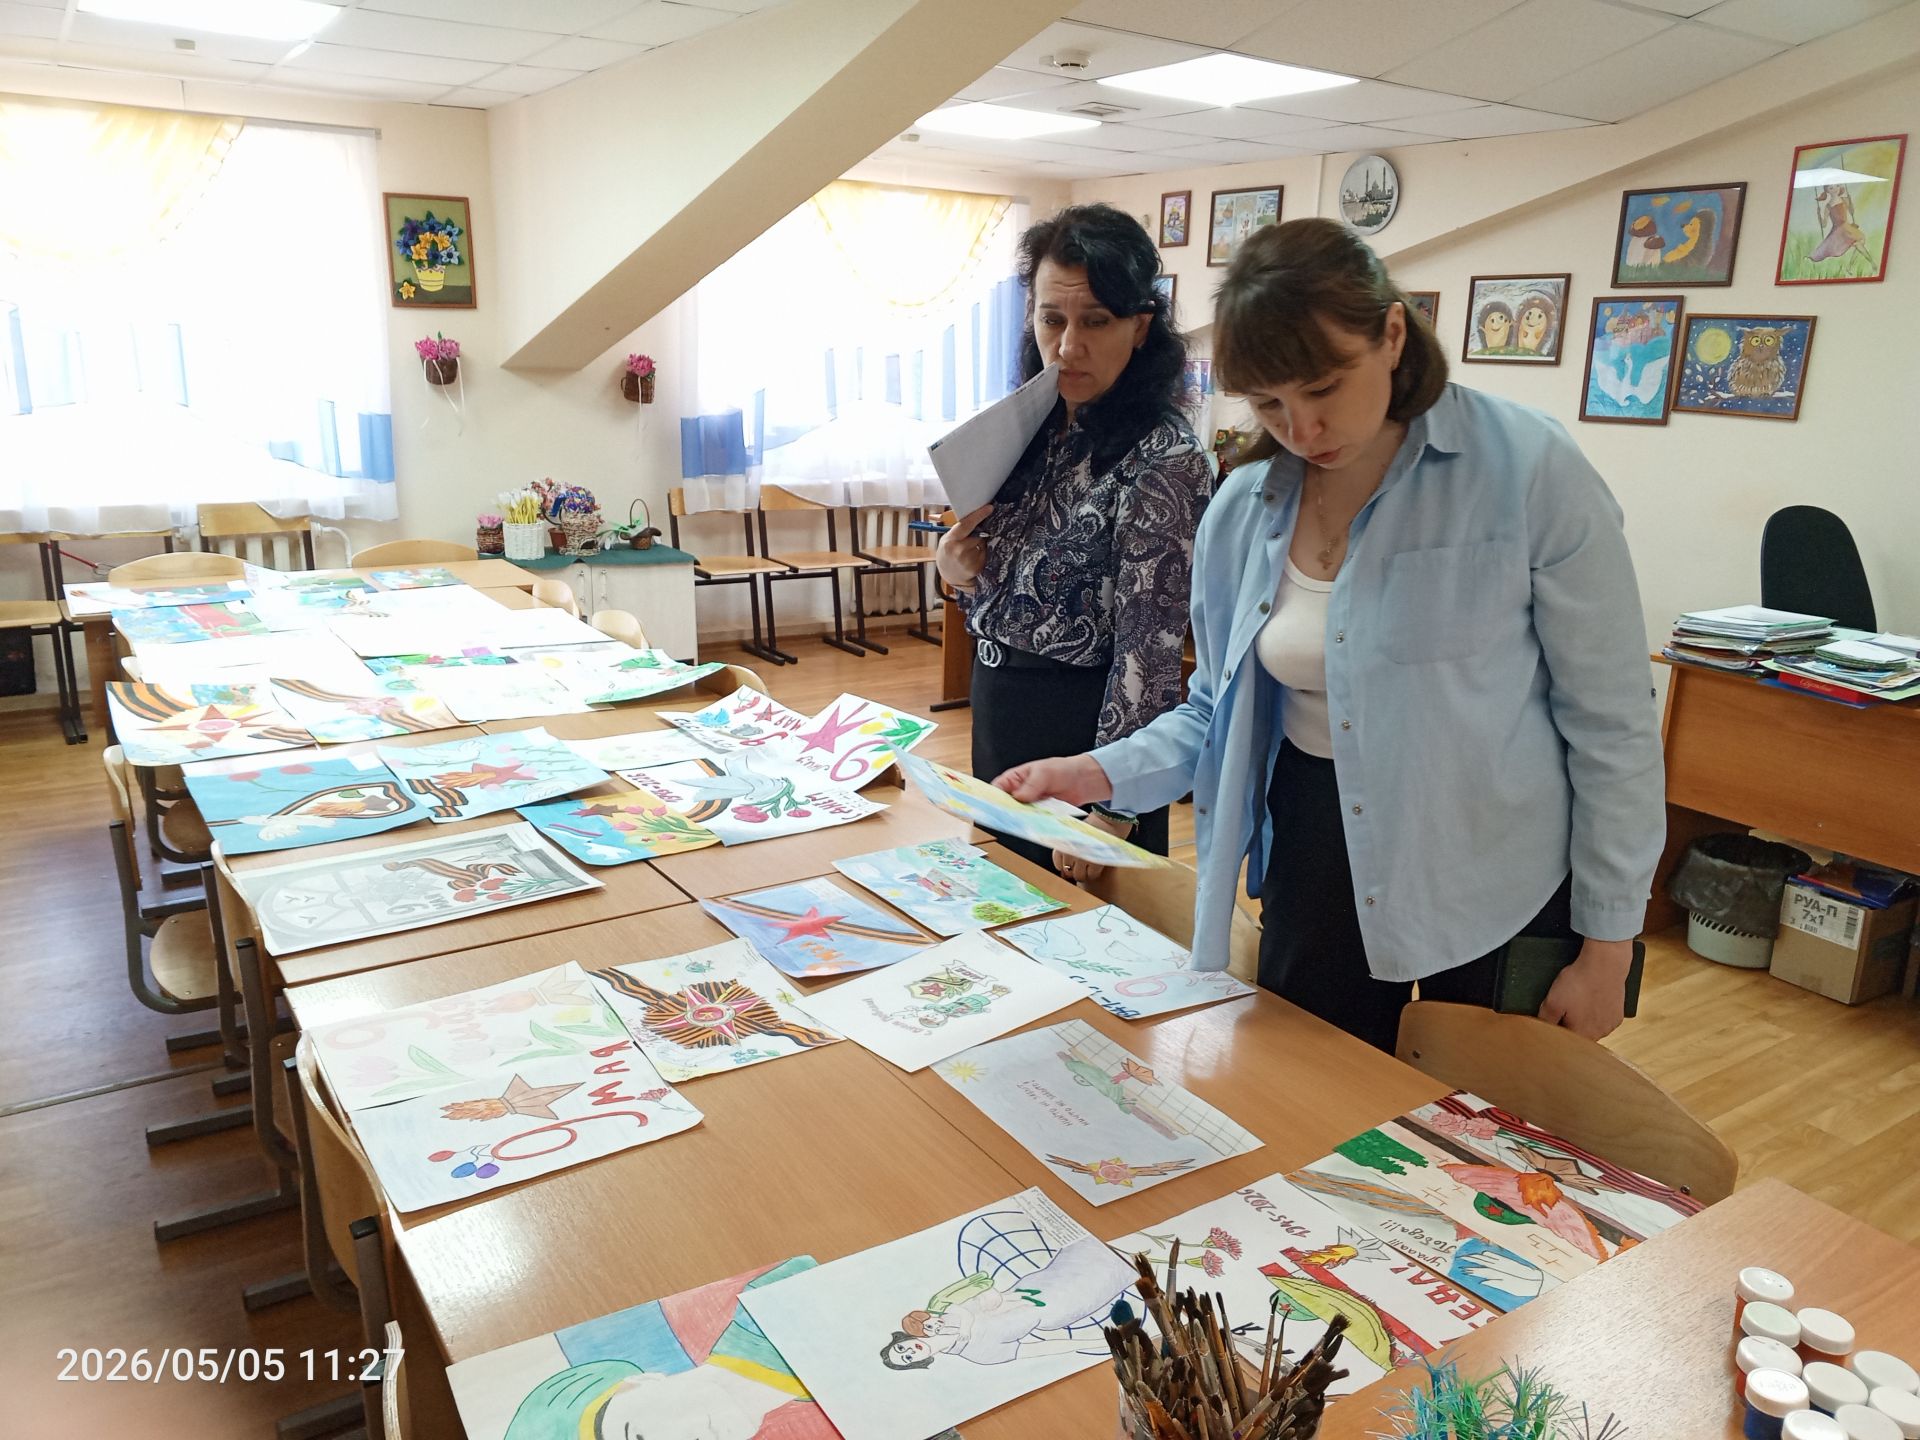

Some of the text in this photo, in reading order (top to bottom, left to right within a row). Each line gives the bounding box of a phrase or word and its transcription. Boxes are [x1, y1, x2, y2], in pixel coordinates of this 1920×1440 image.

[829, 739, 890, 782] 9
[1793, 894, 1838, 918] РУА-П
[490, 1110, 649, 1162] 9
[1235, 1188, 1312, 1239] 1945-2026
[1379, 1219, 1458, 1254] Победа!!!
